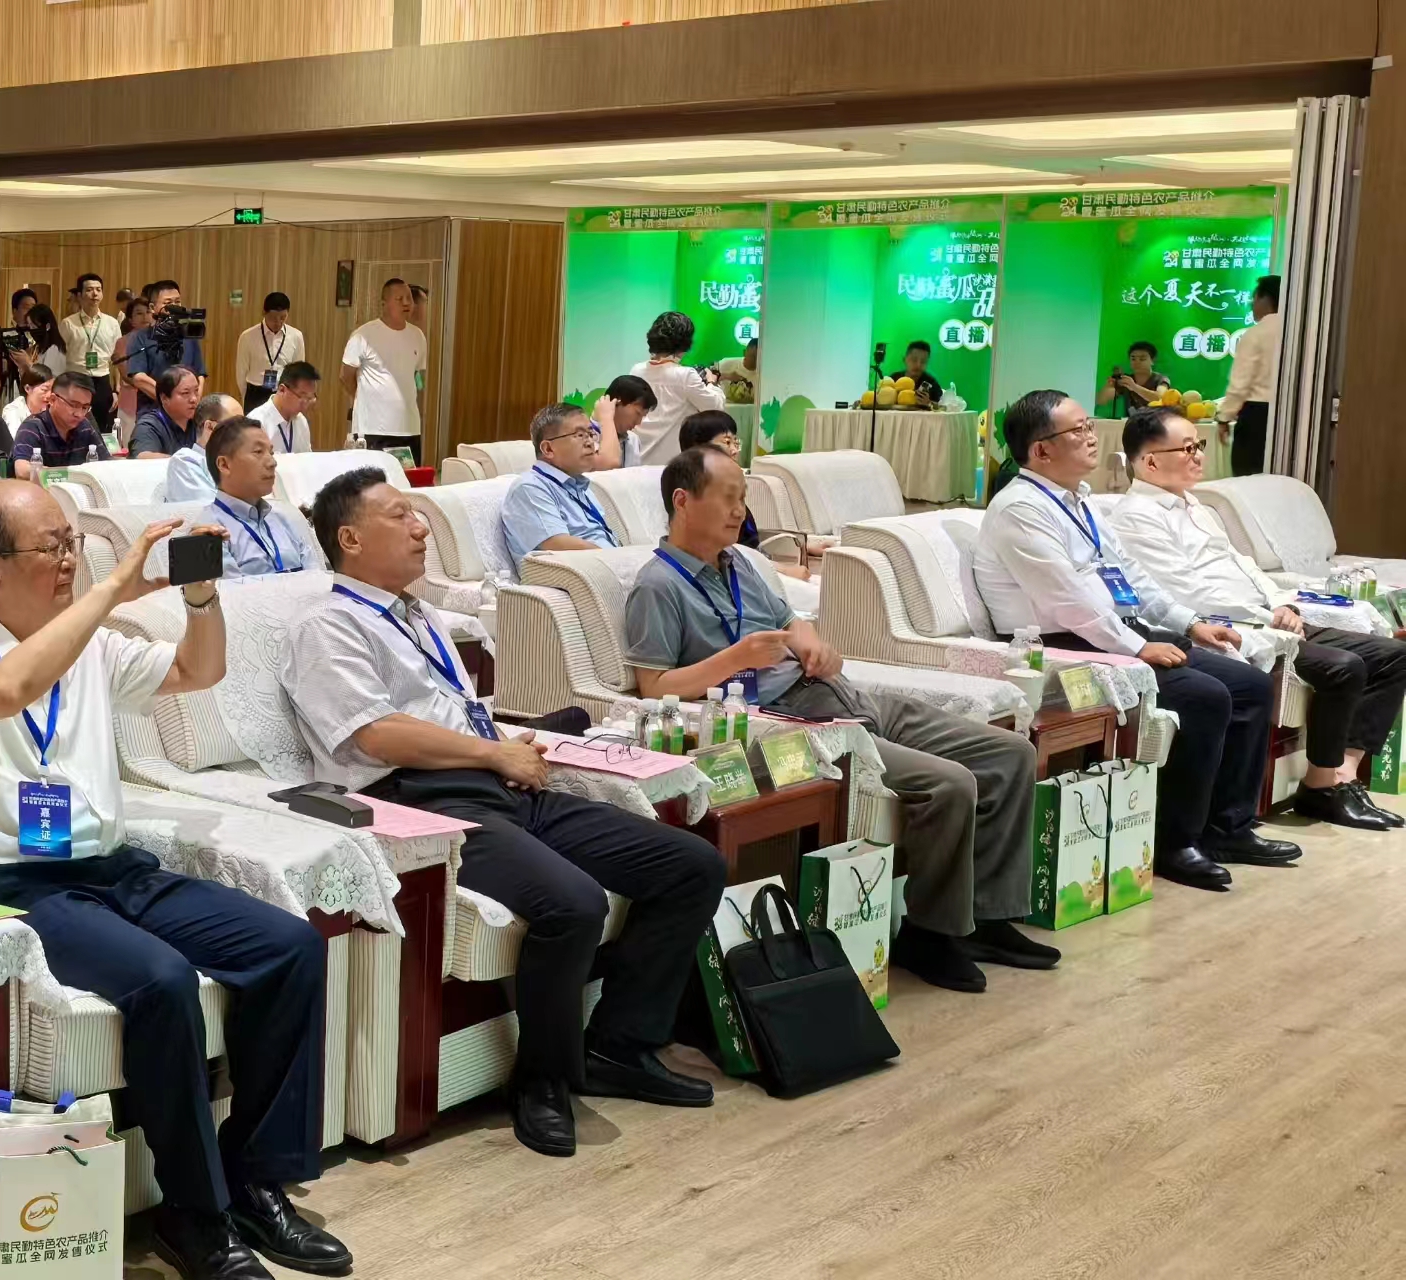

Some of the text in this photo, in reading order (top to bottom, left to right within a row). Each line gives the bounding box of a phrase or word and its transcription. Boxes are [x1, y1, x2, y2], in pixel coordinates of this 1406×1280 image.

[1082, 191, 1215, 206] 甘肃民勤特色农产品推介
[39, 807, 51, 840] 嘉宾证
